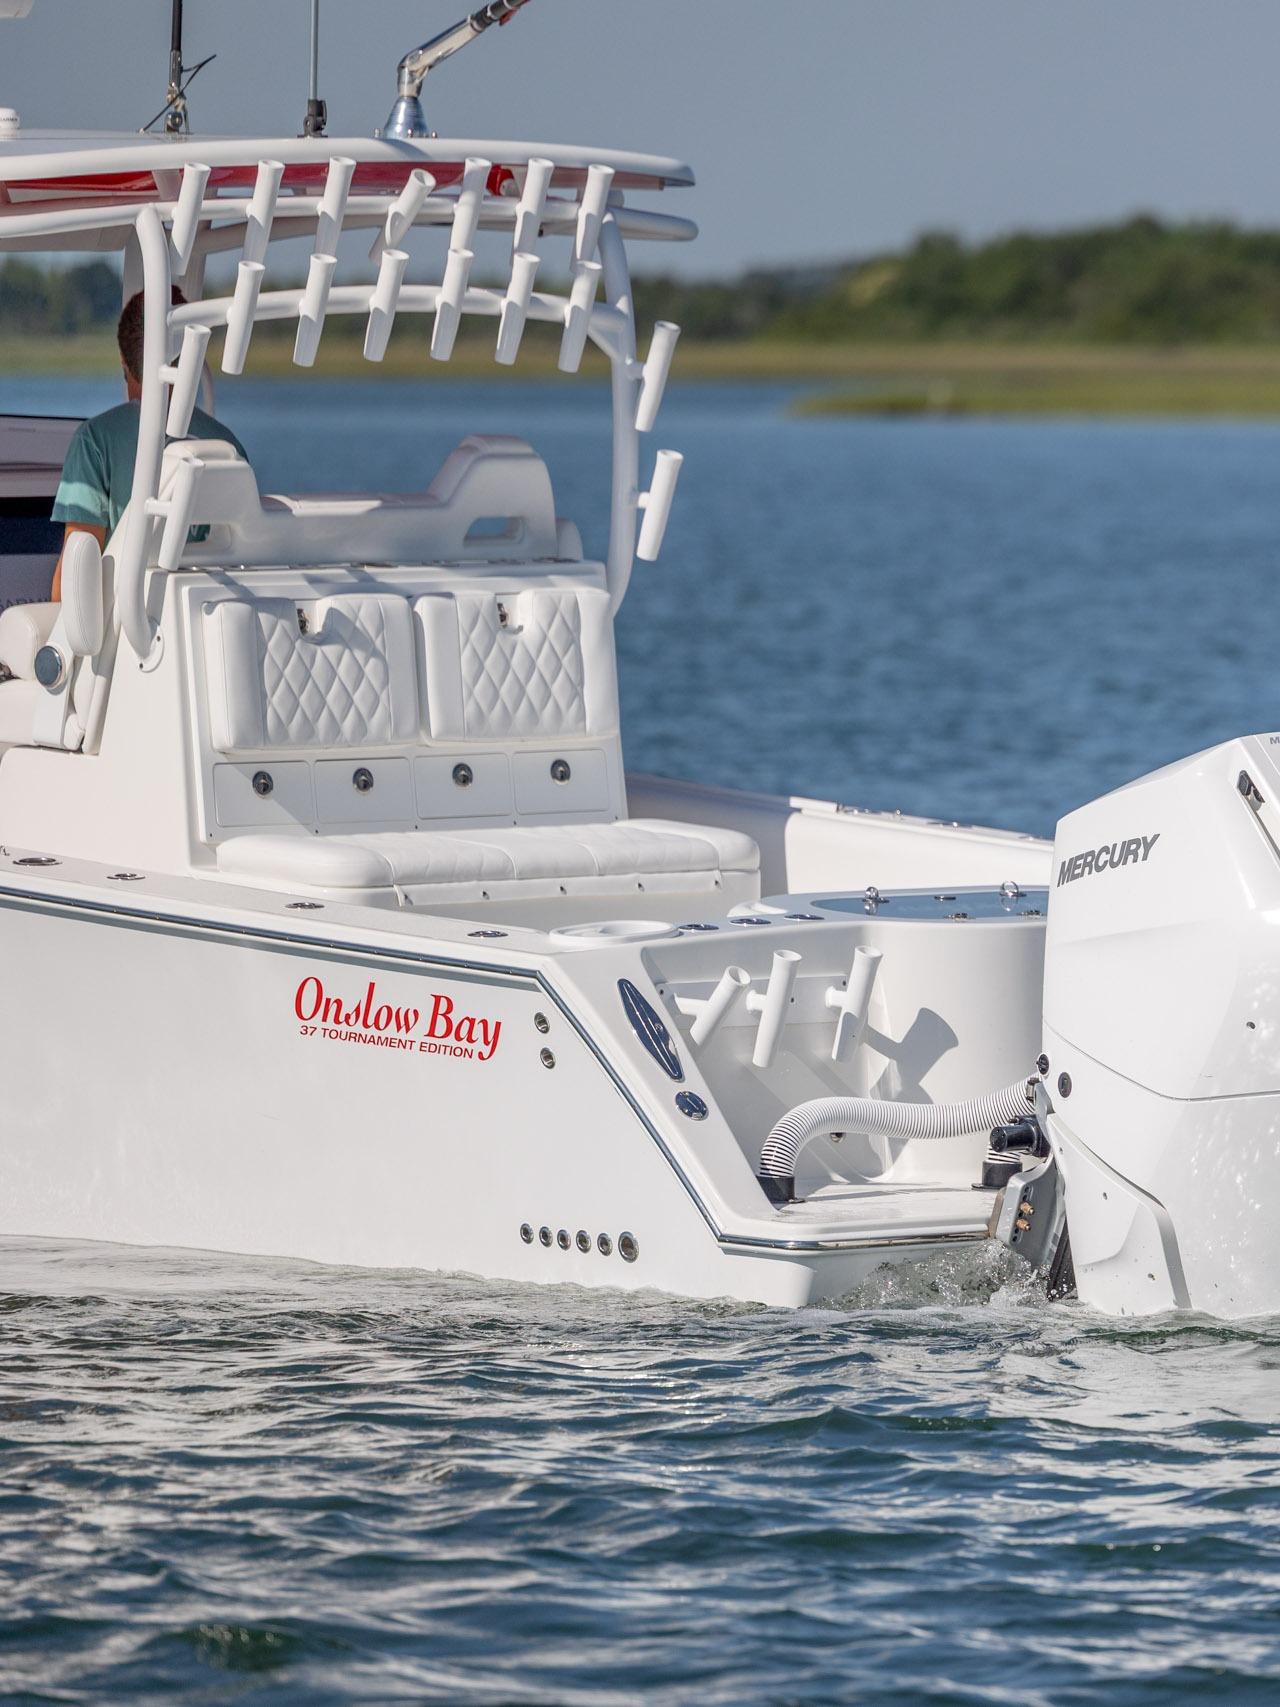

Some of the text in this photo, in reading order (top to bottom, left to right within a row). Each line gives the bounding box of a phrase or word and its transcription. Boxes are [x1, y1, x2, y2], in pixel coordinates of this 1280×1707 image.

[1056, 833, 1161, 888] MERCURY
[294, 976, 503, 1061] Onslow Bay
[299, 1024, 474, 1059] 37 TOURNAMENT EDITION
